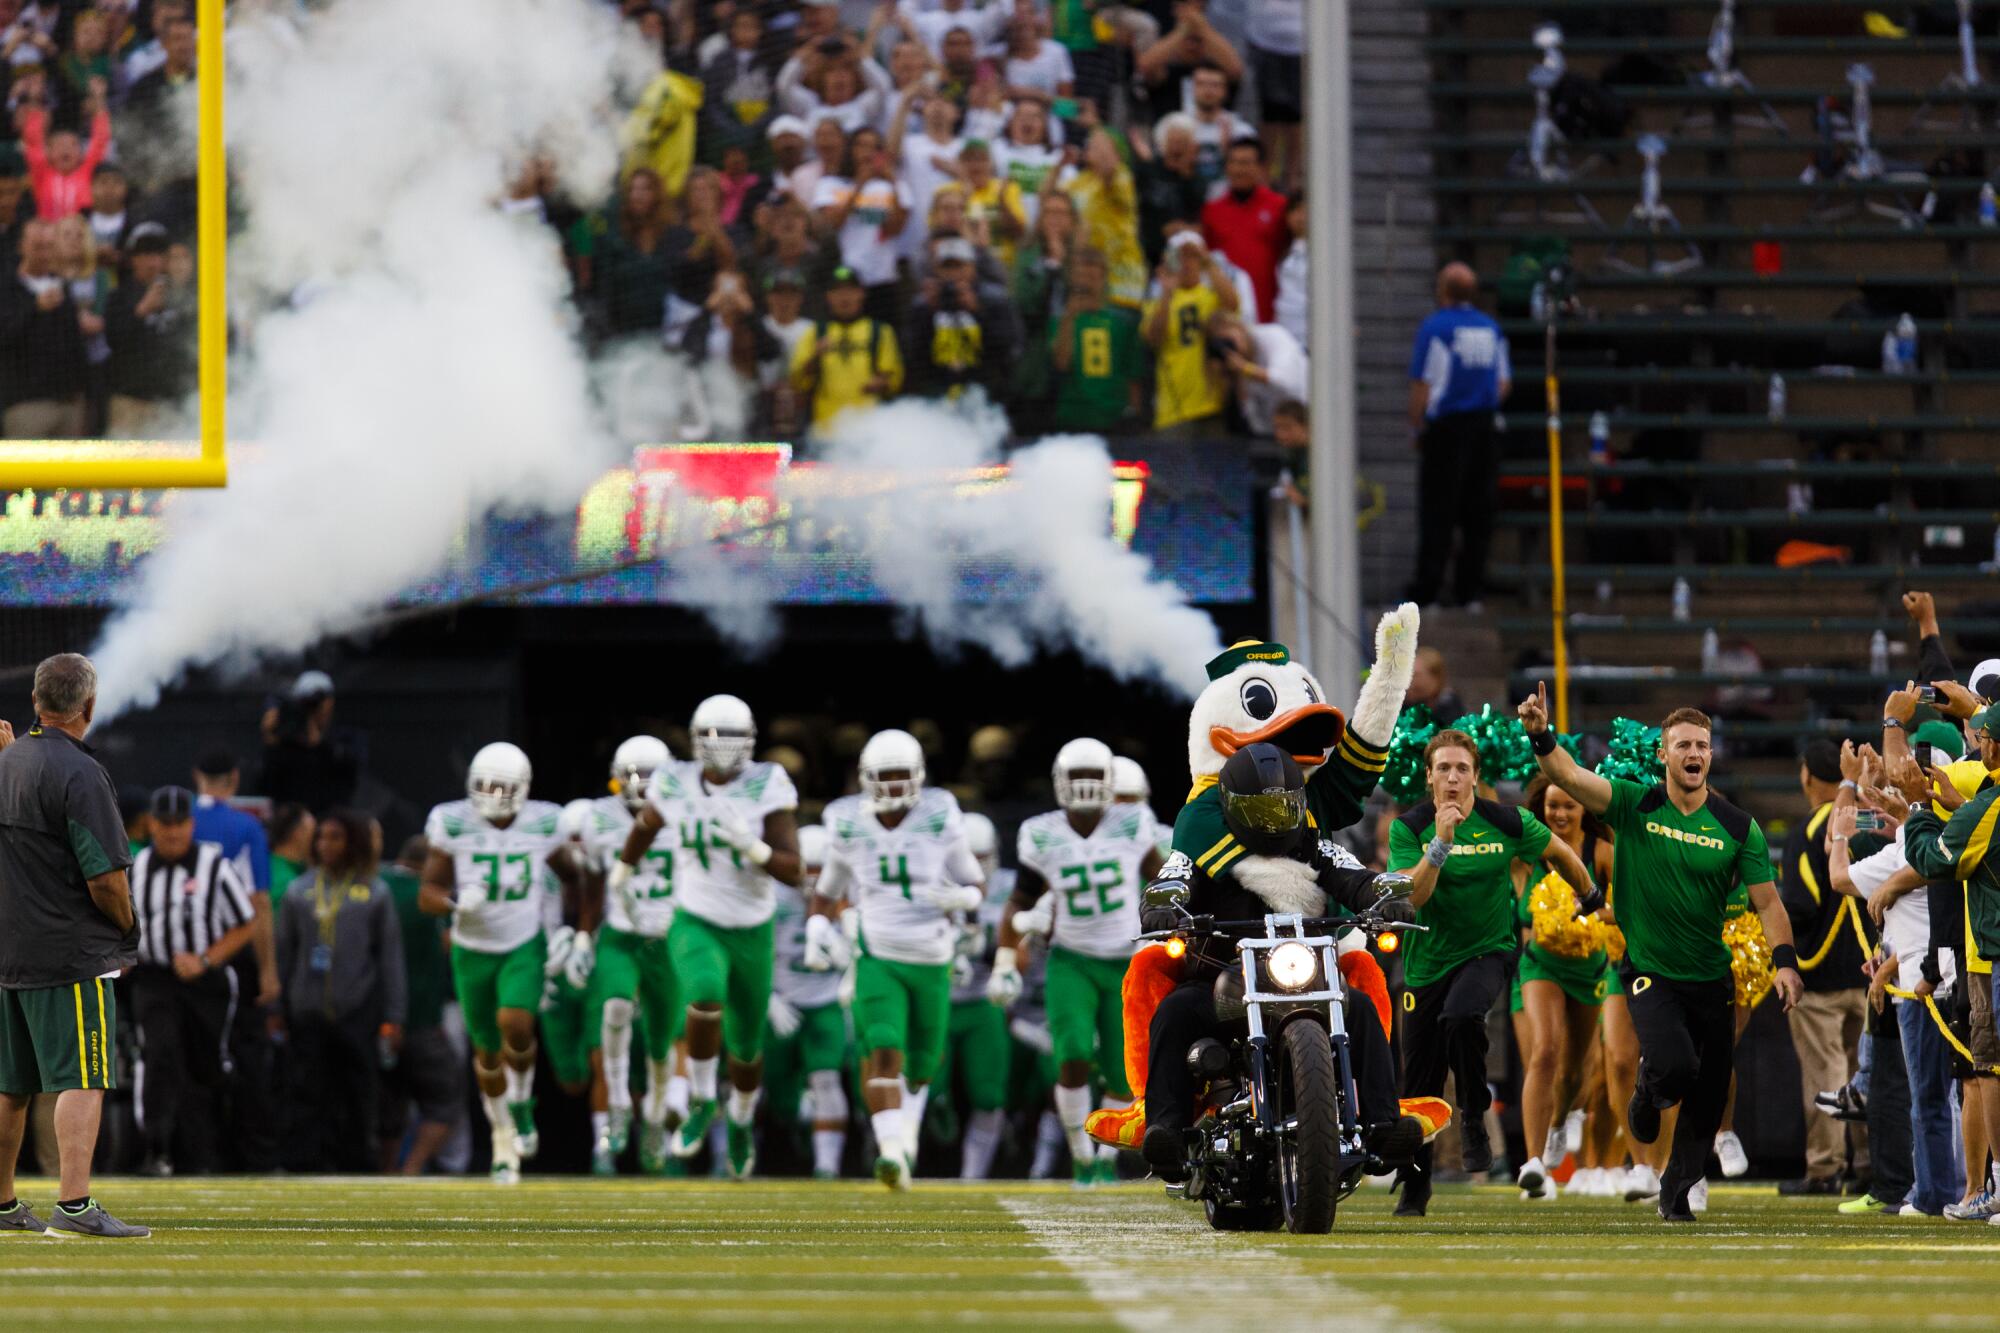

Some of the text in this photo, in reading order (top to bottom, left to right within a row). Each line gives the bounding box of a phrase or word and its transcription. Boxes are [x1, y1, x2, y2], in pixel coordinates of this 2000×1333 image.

[1646, 822, 1724, 850] OREGON
[879, 855, 913, 901] 4
[1061, 861, 1124, 916] 22
[91, 1030, 99, 1077] OREGON
